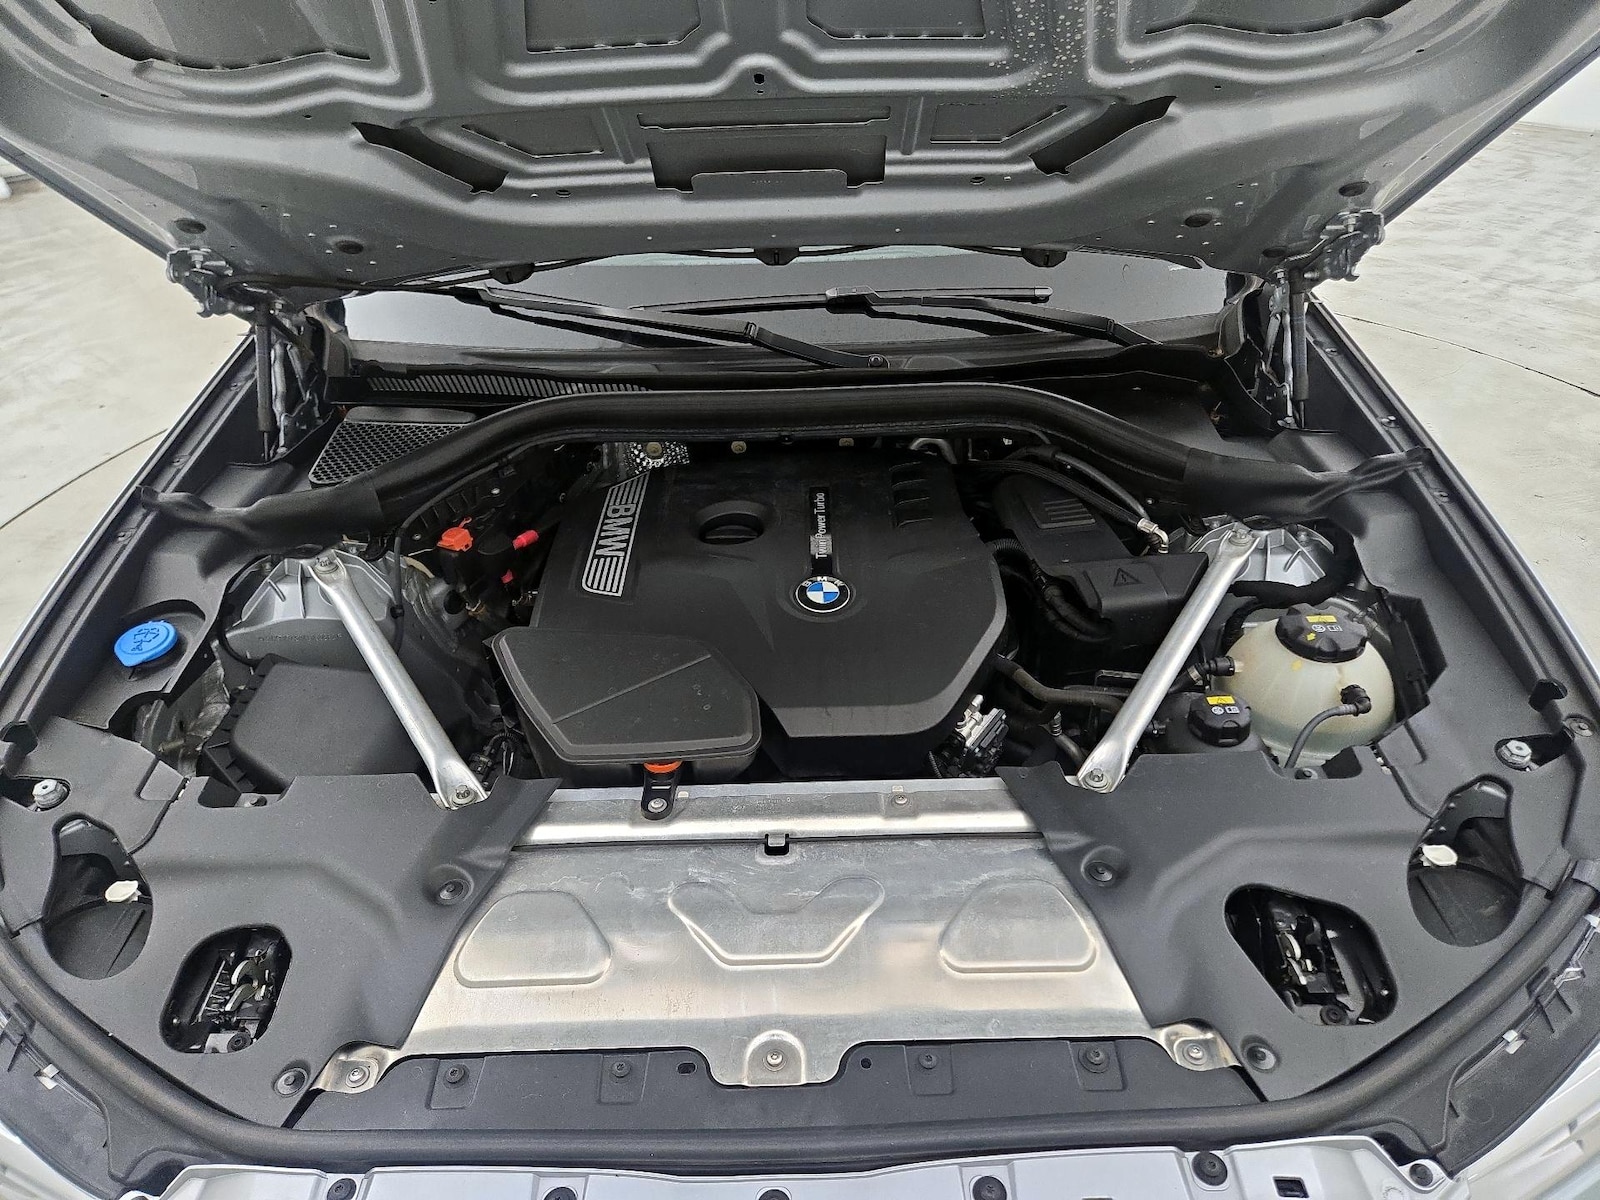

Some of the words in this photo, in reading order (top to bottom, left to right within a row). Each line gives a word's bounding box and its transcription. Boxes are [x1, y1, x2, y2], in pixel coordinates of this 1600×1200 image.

[813, 492, 826, 514] Turbo
[595, 503, 637, 557] BMW
[802, 576, 844, 587] BMW
